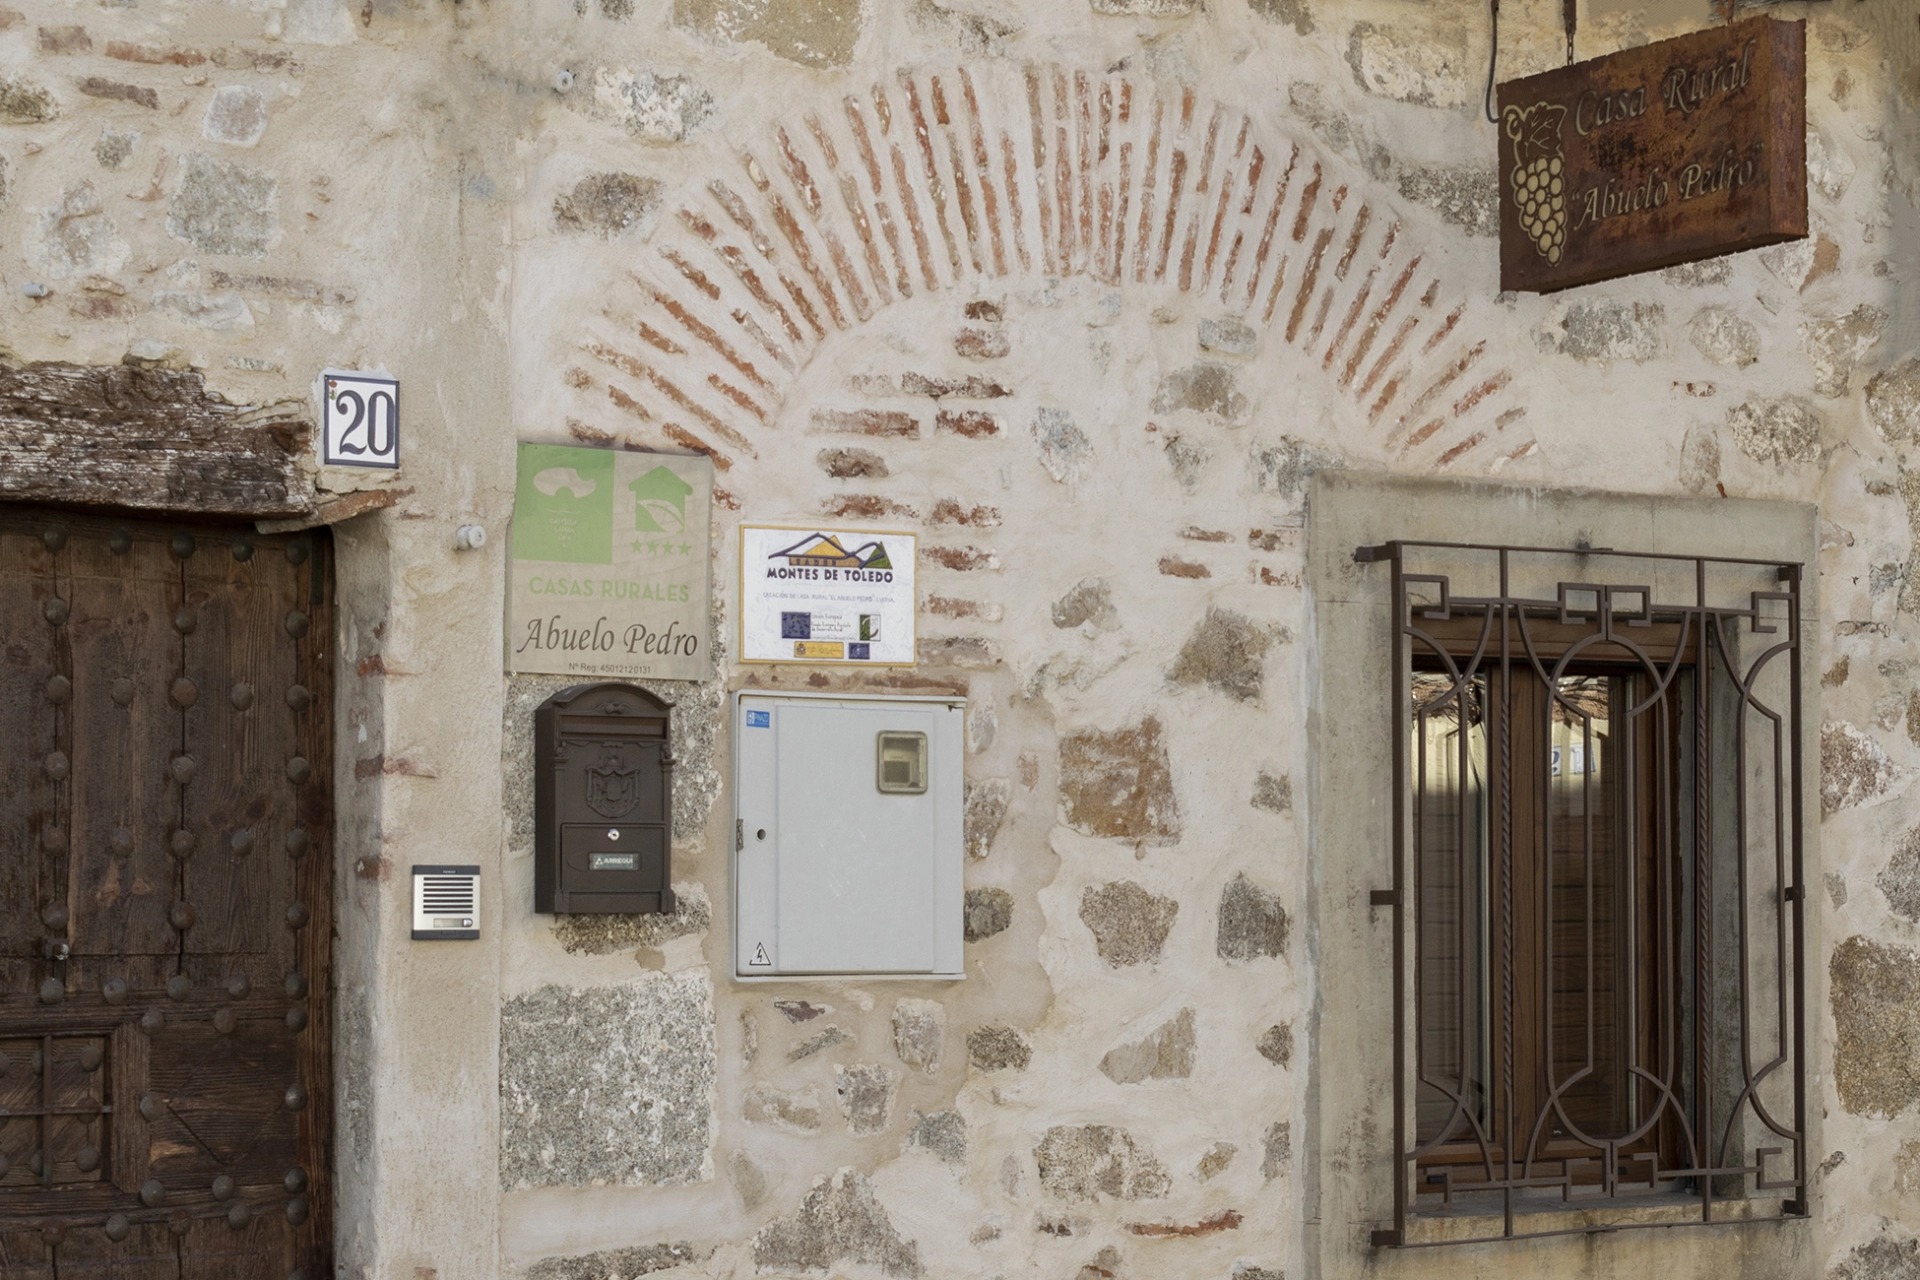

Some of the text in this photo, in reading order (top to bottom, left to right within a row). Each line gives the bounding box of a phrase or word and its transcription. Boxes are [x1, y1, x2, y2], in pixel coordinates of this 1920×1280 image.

[1575, 38, 1756, 137] Casa Rural
[335, 389, 395, 457] 20
[529, 576, 690, 603] CASAS RURALES
[766, 567, 893, 583] MONTES DE TOLEDO
[516, 614, 698, 656] Abuelo Pedro
[600, 663, 651, 675] 45012120131
